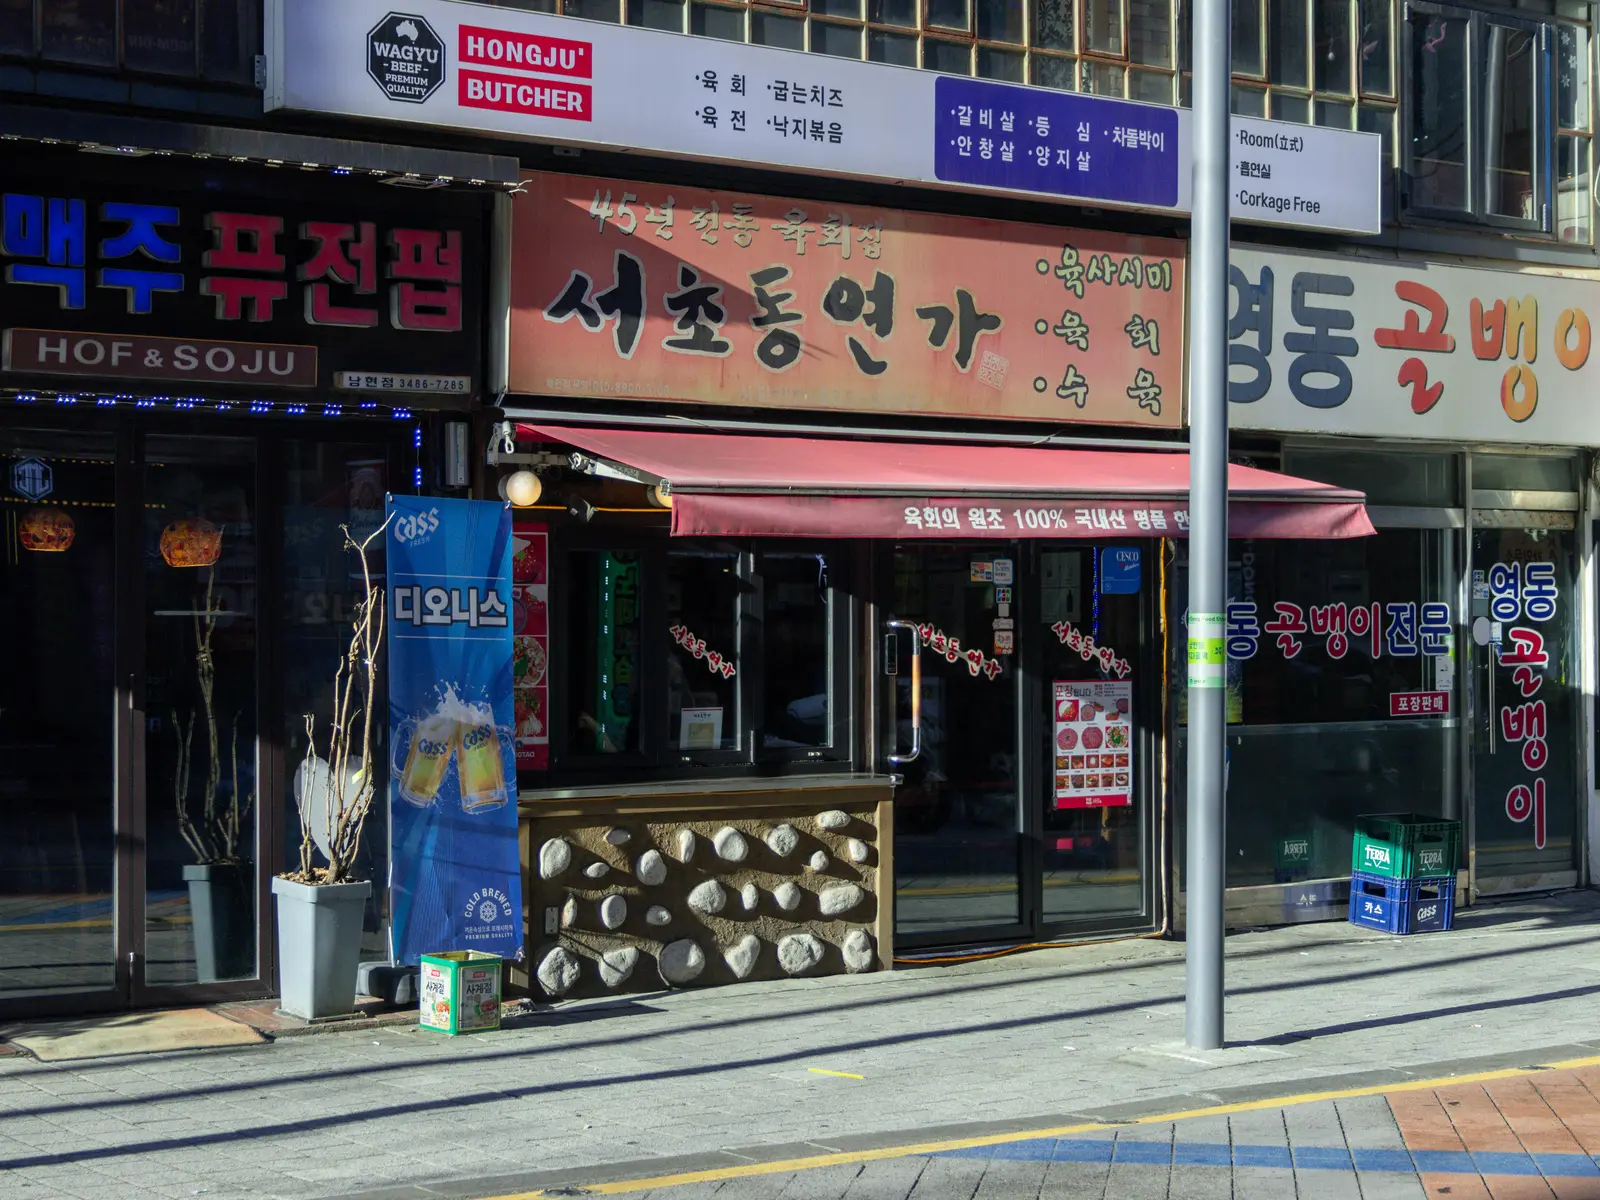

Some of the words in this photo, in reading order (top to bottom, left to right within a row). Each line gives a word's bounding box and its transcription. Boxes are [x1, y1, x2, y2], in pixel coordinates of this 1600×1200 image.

[373, 41, 439, 64] WAGYU
[385, 73, 428, 86] PREMIUM
[387, 84, 427, 96] QUALITY
[467, 78, 583, 113] BUTCHER
[773, 80, 844, 107] 굽는치즈
[773, 115, 843, 144] 낙지볶음
[1113, 126, 1164, 152] 차돌박이
[1240, 190, 1290, 213] Corkage
[1294, 197, 1320, 213] Free
[590, 190, 675, 240] 45년
[690, 201, 760, 248] 전통
[772, 207, 883, 259] 육회집
[1054, 243, 1172, 299] 육사시미
[38, 337, 133, 367] HOF
[144, 349, 164, 369] &
[173, 344, 295, 375] SOJU
[904, 506, 960, 530] 육회의
[968, 507, 1005, 530] 원조
[1013, 508, 1068, 530] 100%
[1074, 508, 1127, 530] 국내산
[1133, 509, 1168, 531] 명품
[410, 536, 430, 547] FRESH
[1489, 561, 1558, 622] 영동
[394, 585, 508, 628] 디오니스
[1397, 697, 1444, 712] 포장판매
[1365, 845, 1391, 864] TERRA
[1419, 850, 1443, 864] TERRA
[464, 892, 481, 918] COLD
[482, 887, 512, 916] BREWED
[1364, 901, 1383, 914] 카스
[466, 982, 492, 995] 사계절
